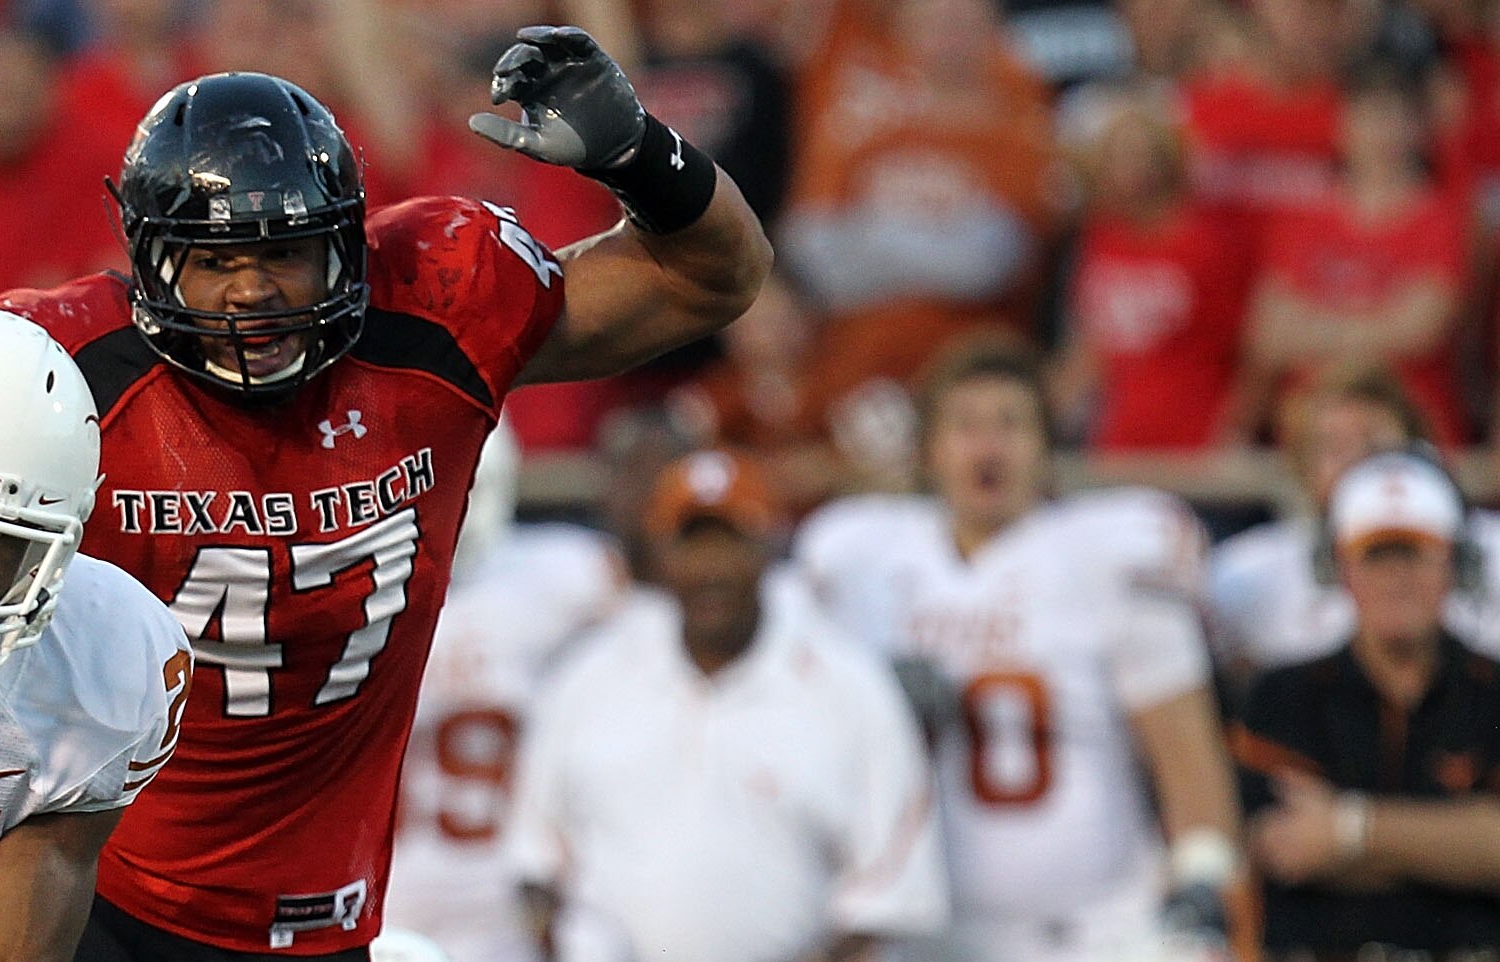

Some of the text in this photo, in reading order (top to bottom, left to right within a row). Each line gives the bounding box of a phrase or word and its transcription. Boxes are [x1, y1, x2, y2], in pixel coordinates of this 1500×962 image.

[480, 199, 564, 290] 4
[112, 447, 435, 536] TEXAS TECH
[168, 506, 421, 717] 47
